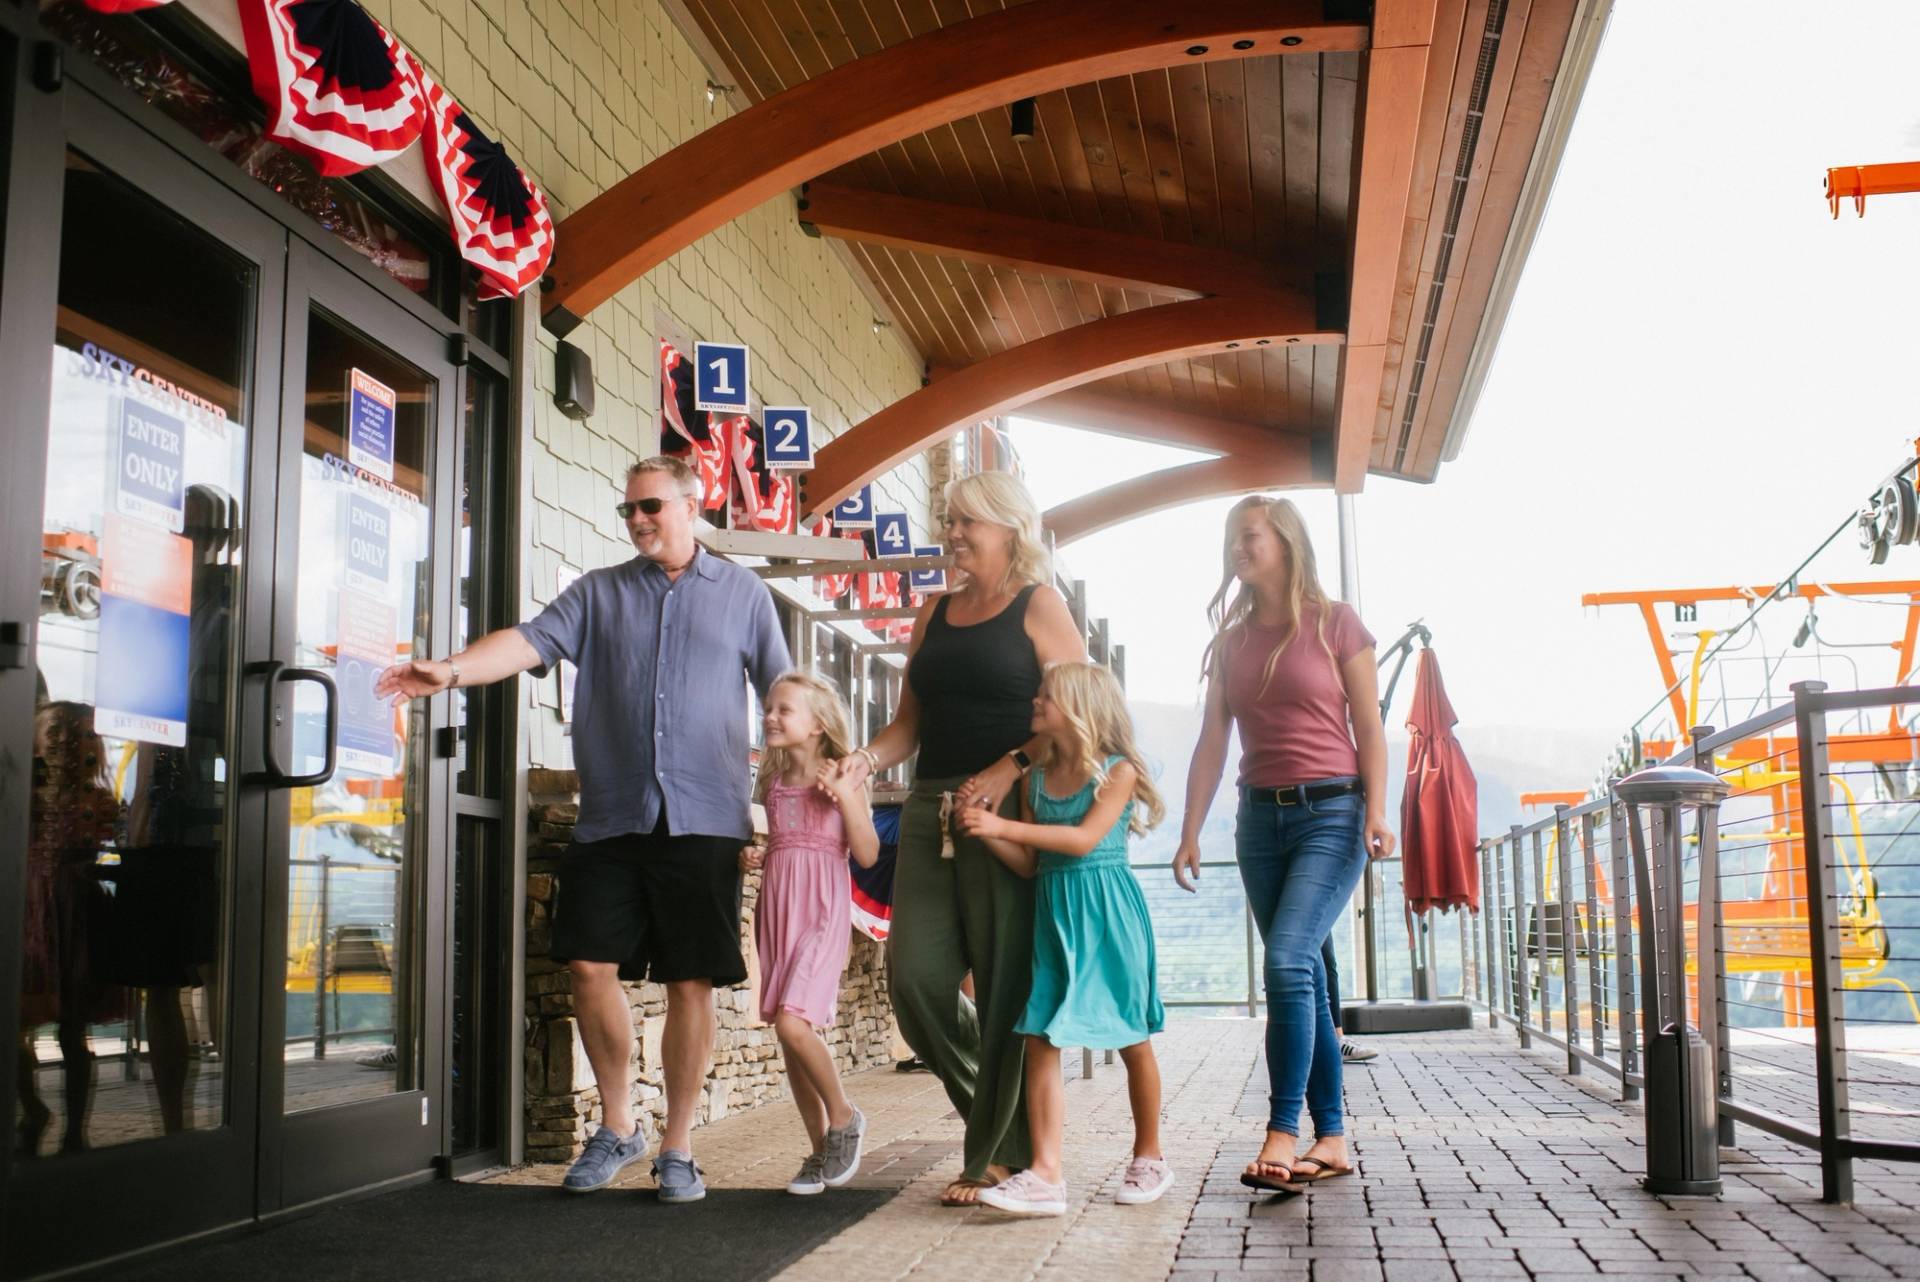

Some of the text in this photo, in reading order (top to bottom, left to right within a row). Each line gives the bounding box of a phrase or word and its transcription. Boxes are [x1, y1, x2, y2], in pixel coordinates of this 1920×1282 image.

[82, 342, 227, 438] SKYCENTER
[357, 375, 392, 406] WELCOME
[709, 357, 736, 394] 1
[127, 414, 181, 456] ENTER
[774, 419, 800, 452] 2
[126, 452, 179, 494] ONLY
[842, 490, 864, 514] 3
[351, 506, 388, 537] ENTER
[883, 521, 904, 548] 4
[351, 537, 386, 569] ONLY
